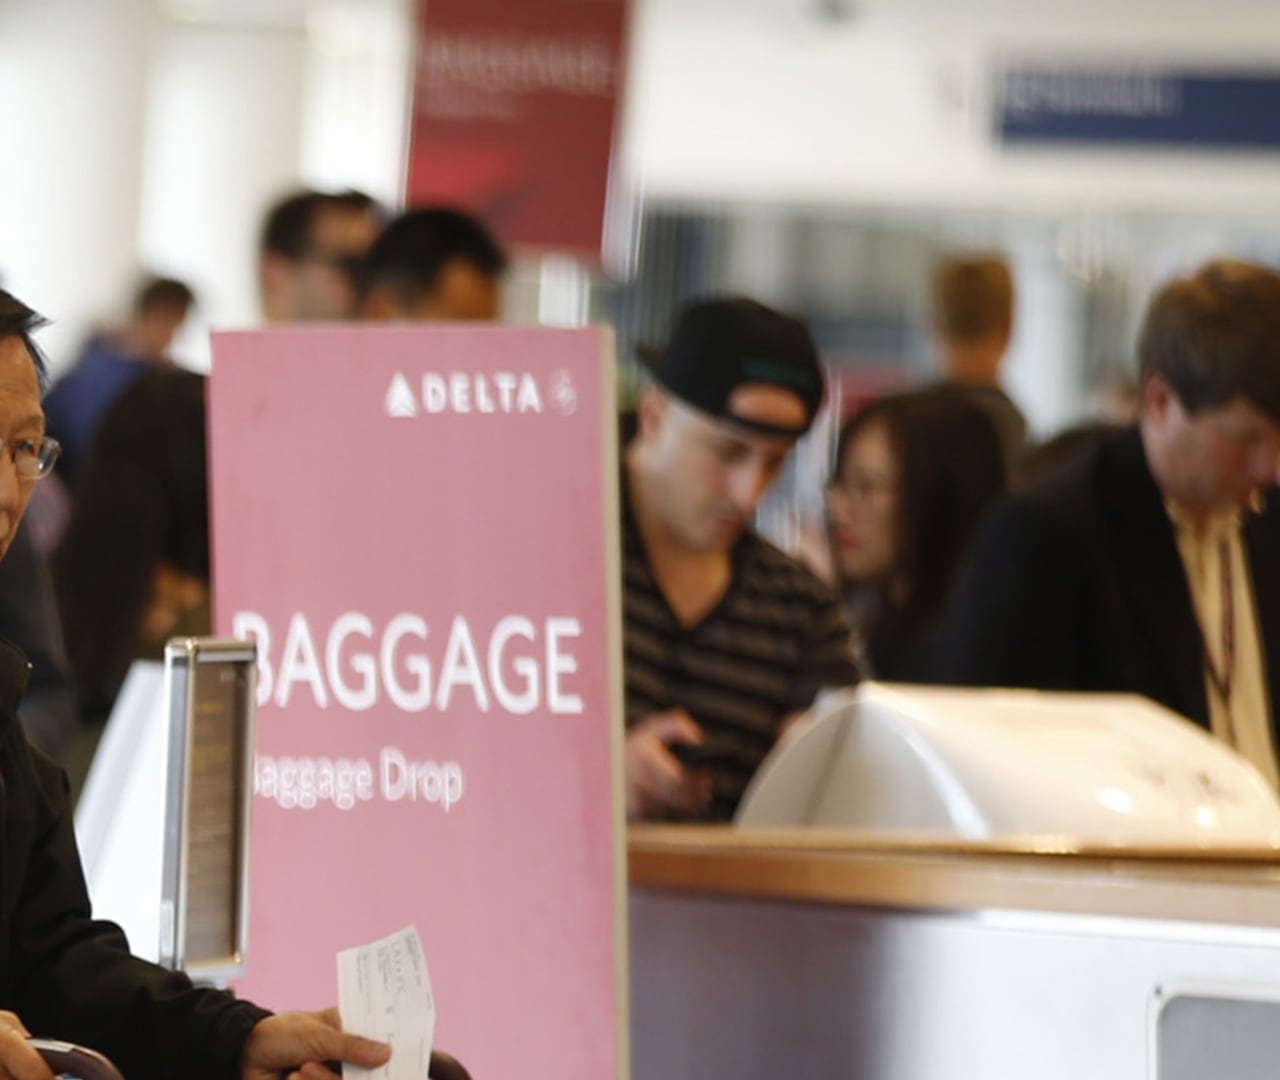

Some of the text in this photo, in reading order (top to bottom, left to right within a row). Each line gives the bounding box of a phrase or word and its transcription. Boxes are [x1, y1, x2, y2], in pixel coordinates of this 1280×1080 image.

[422, 370, 543, 415] DELTA
[233, 612, 583, 714] BAGGAGE
[255, 745, 463, 813] aggage Drop
